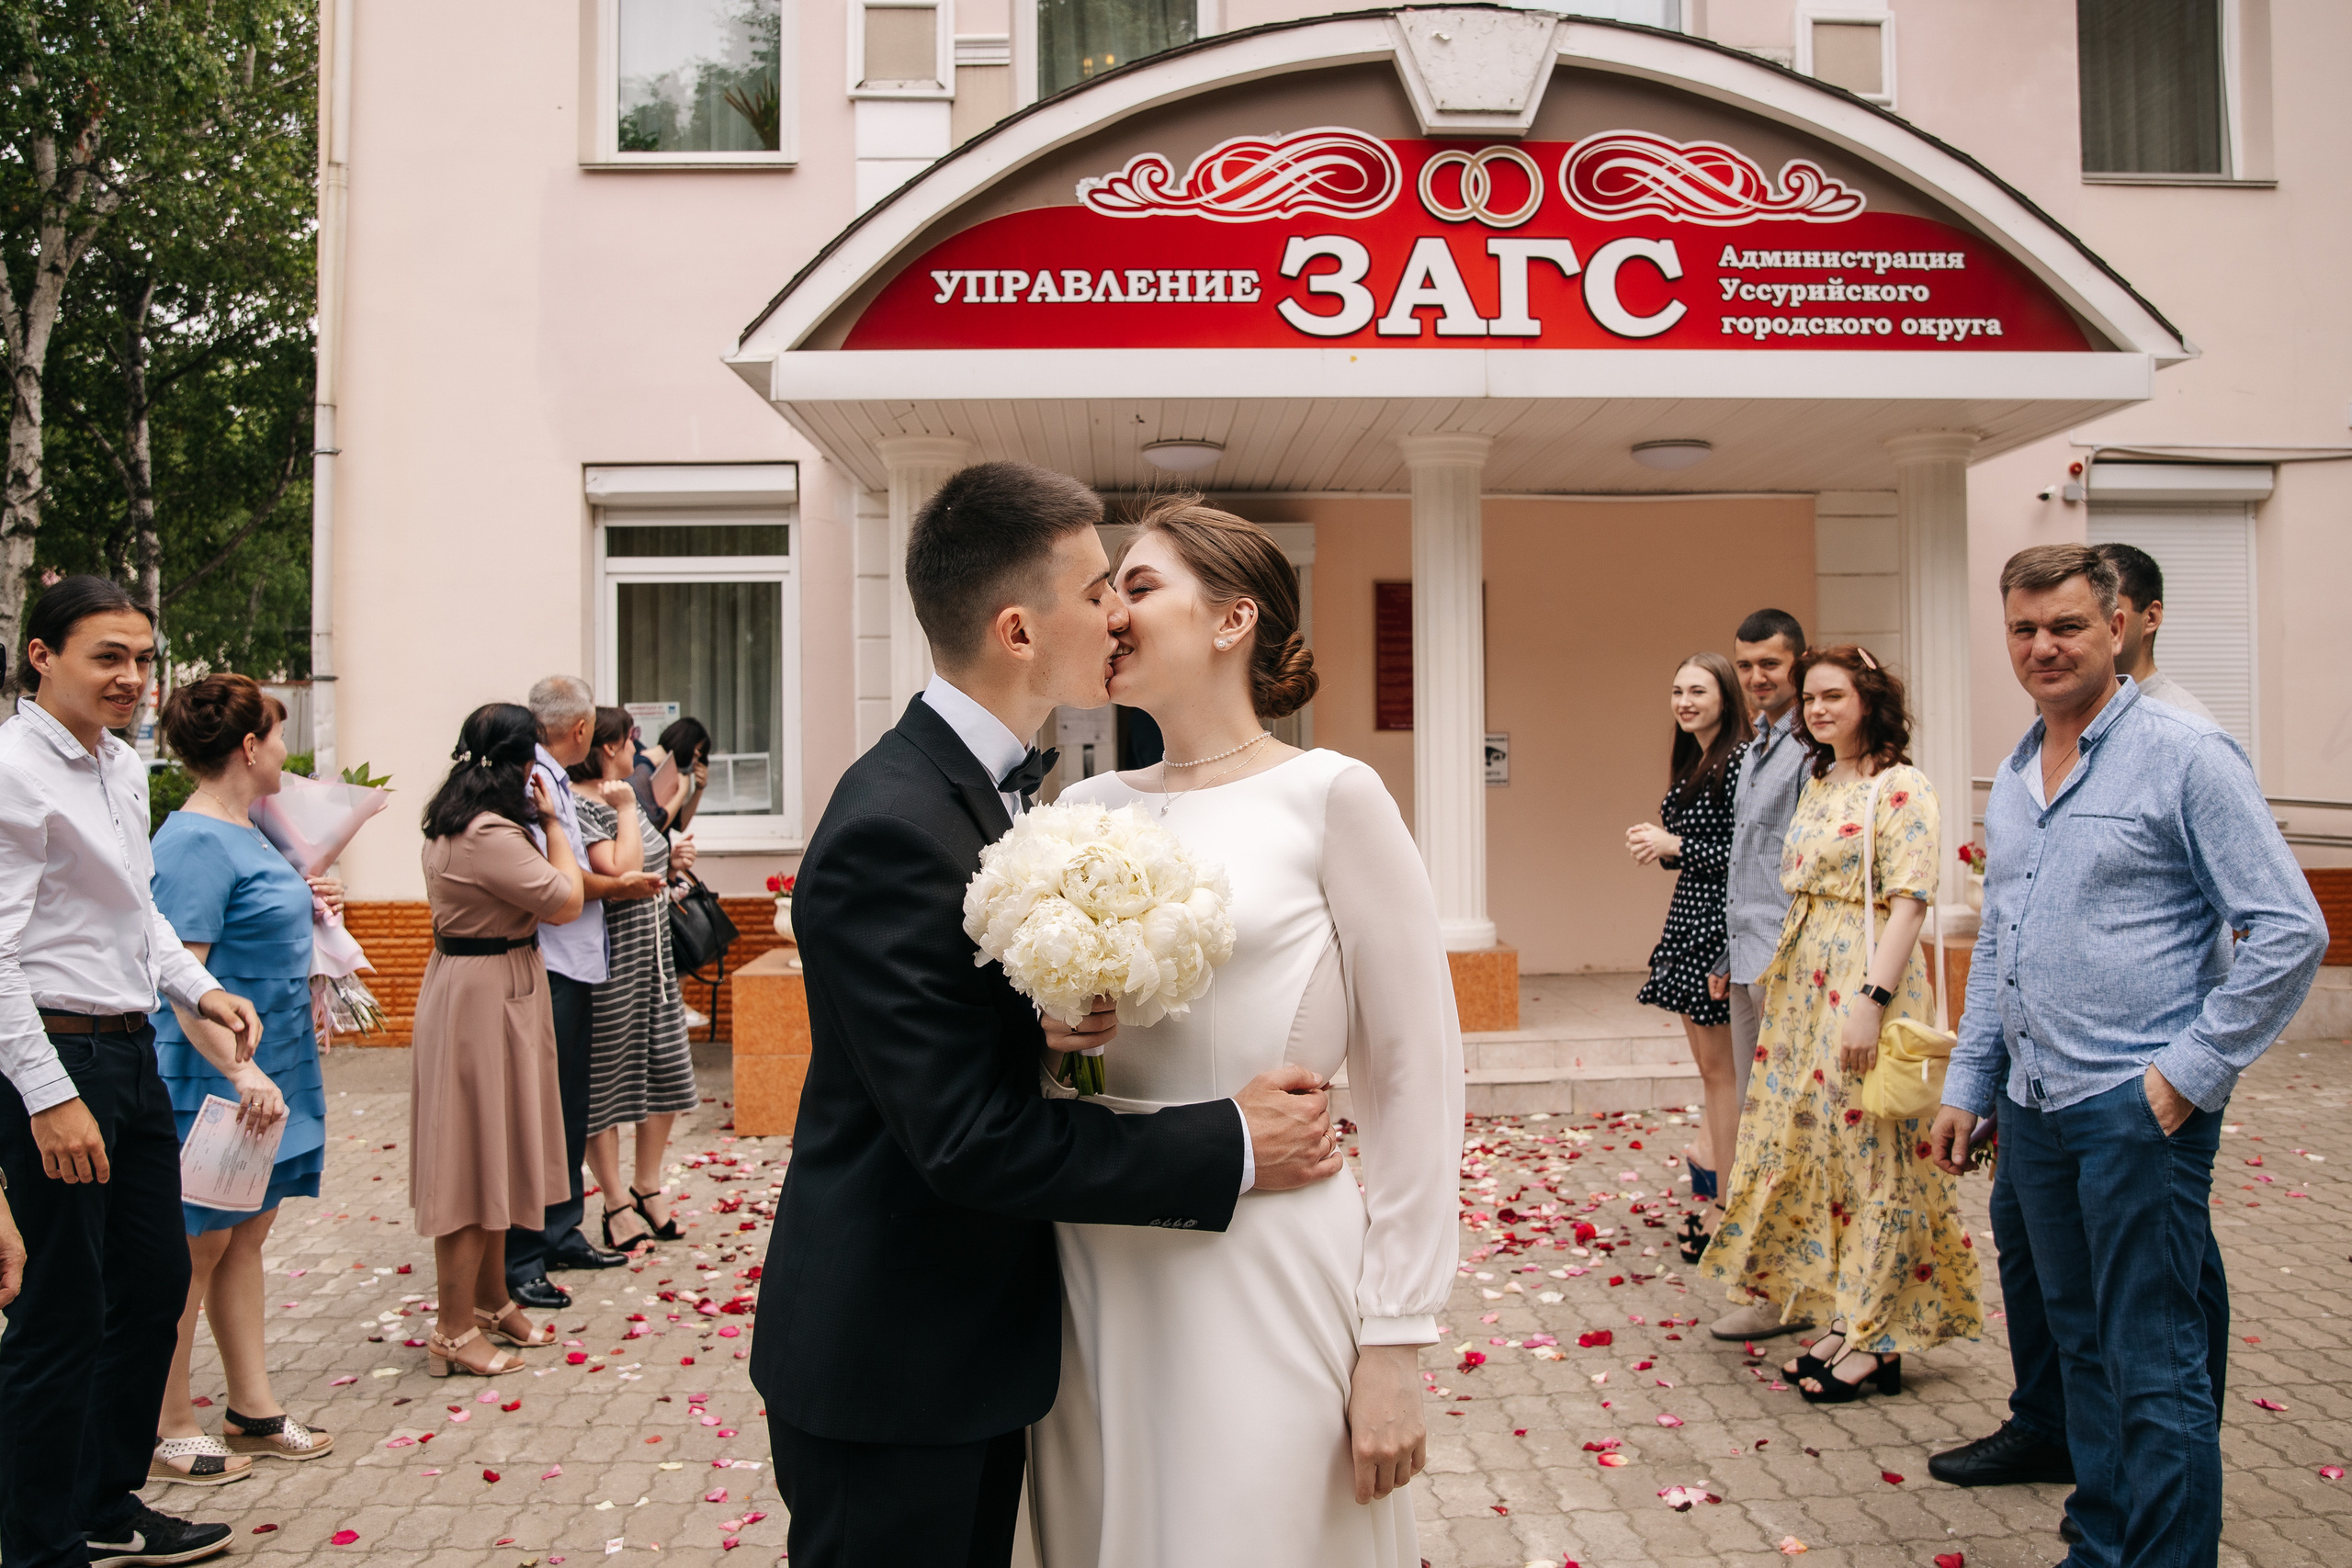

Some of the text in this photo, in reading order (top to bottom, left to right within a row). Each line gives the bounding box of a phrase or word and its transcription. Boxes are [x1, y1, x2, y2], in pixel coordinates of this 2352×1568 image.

[1718, 244, 1965, 274] Администрация
[930, 234, 1688, 337] УПРАВЛЕНИЕ ЗАГС
[1718, 276, 1930, 307] Уссурийского
[1721, 316, 2003, 342] городского округа
